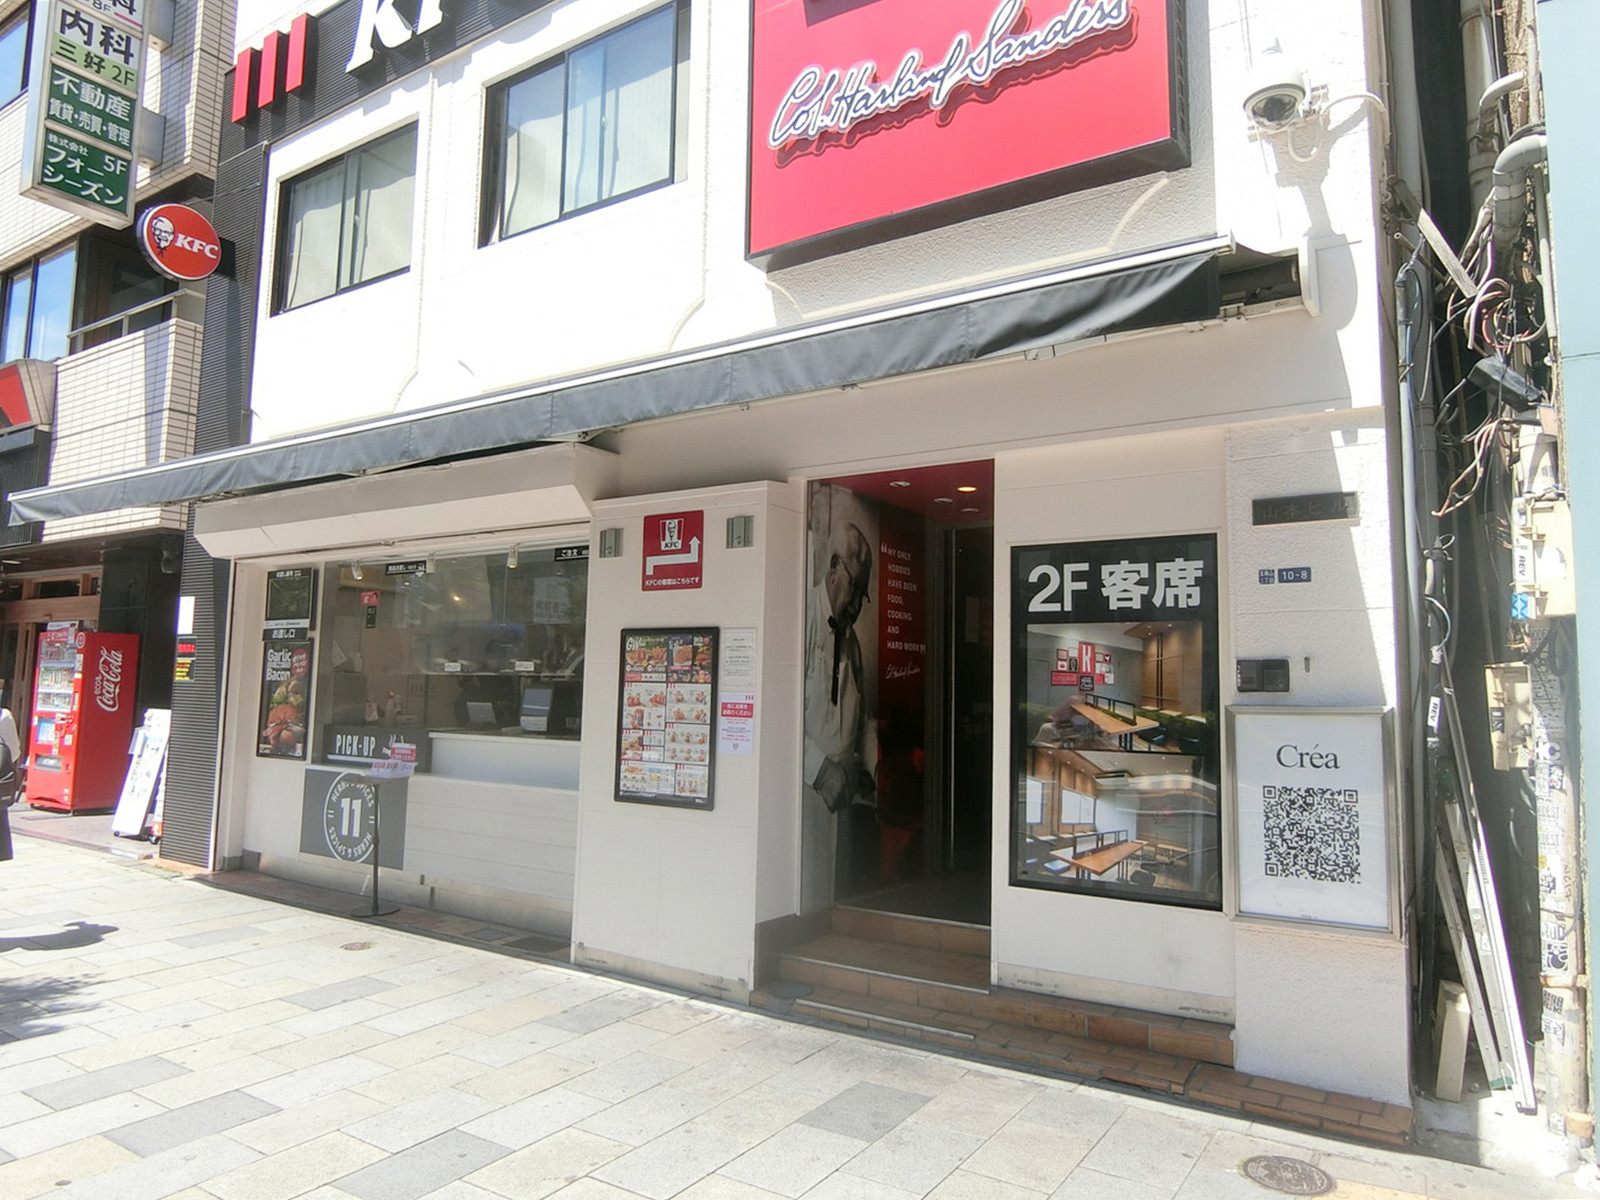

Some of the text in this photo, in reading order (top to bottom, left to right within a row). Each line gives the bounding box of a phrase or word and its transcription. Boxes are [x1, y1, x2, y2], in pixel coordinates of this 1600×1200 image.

[60, 9, 134, 65] 内科
[55, 39, 135, 86] 三好 2F
[53, 69, 130, 122] 不動産
[48, 97, 131, 147] 賃貸・売買・管理
[48, 133, 89, 157] 株式会社
[46, 145, 105, 177] フォー
[103, 155, 128, 175] 5F
[42, 165, 124, 205] シーズン
[175, 233, 219, 259] KFC
[663, 540, 680, 550] KFC
[645, 576, 700, 587] KFCのはこちらです
[1027, 557, 1204, 612] 2F 客席
[1282, 570, 1308, 581] 10-8
[887, 625, 900, 635] AND
[267, 648, 292, 663] Garlic
[97, 645, 123, 712] Coca-Cola
[265, 668, 291, 682] Bacon
[335, 734, 376, 757] PICK-UP
[1276, 743, 1341, 770] Créa
[341, 797, 362, 838] 11
